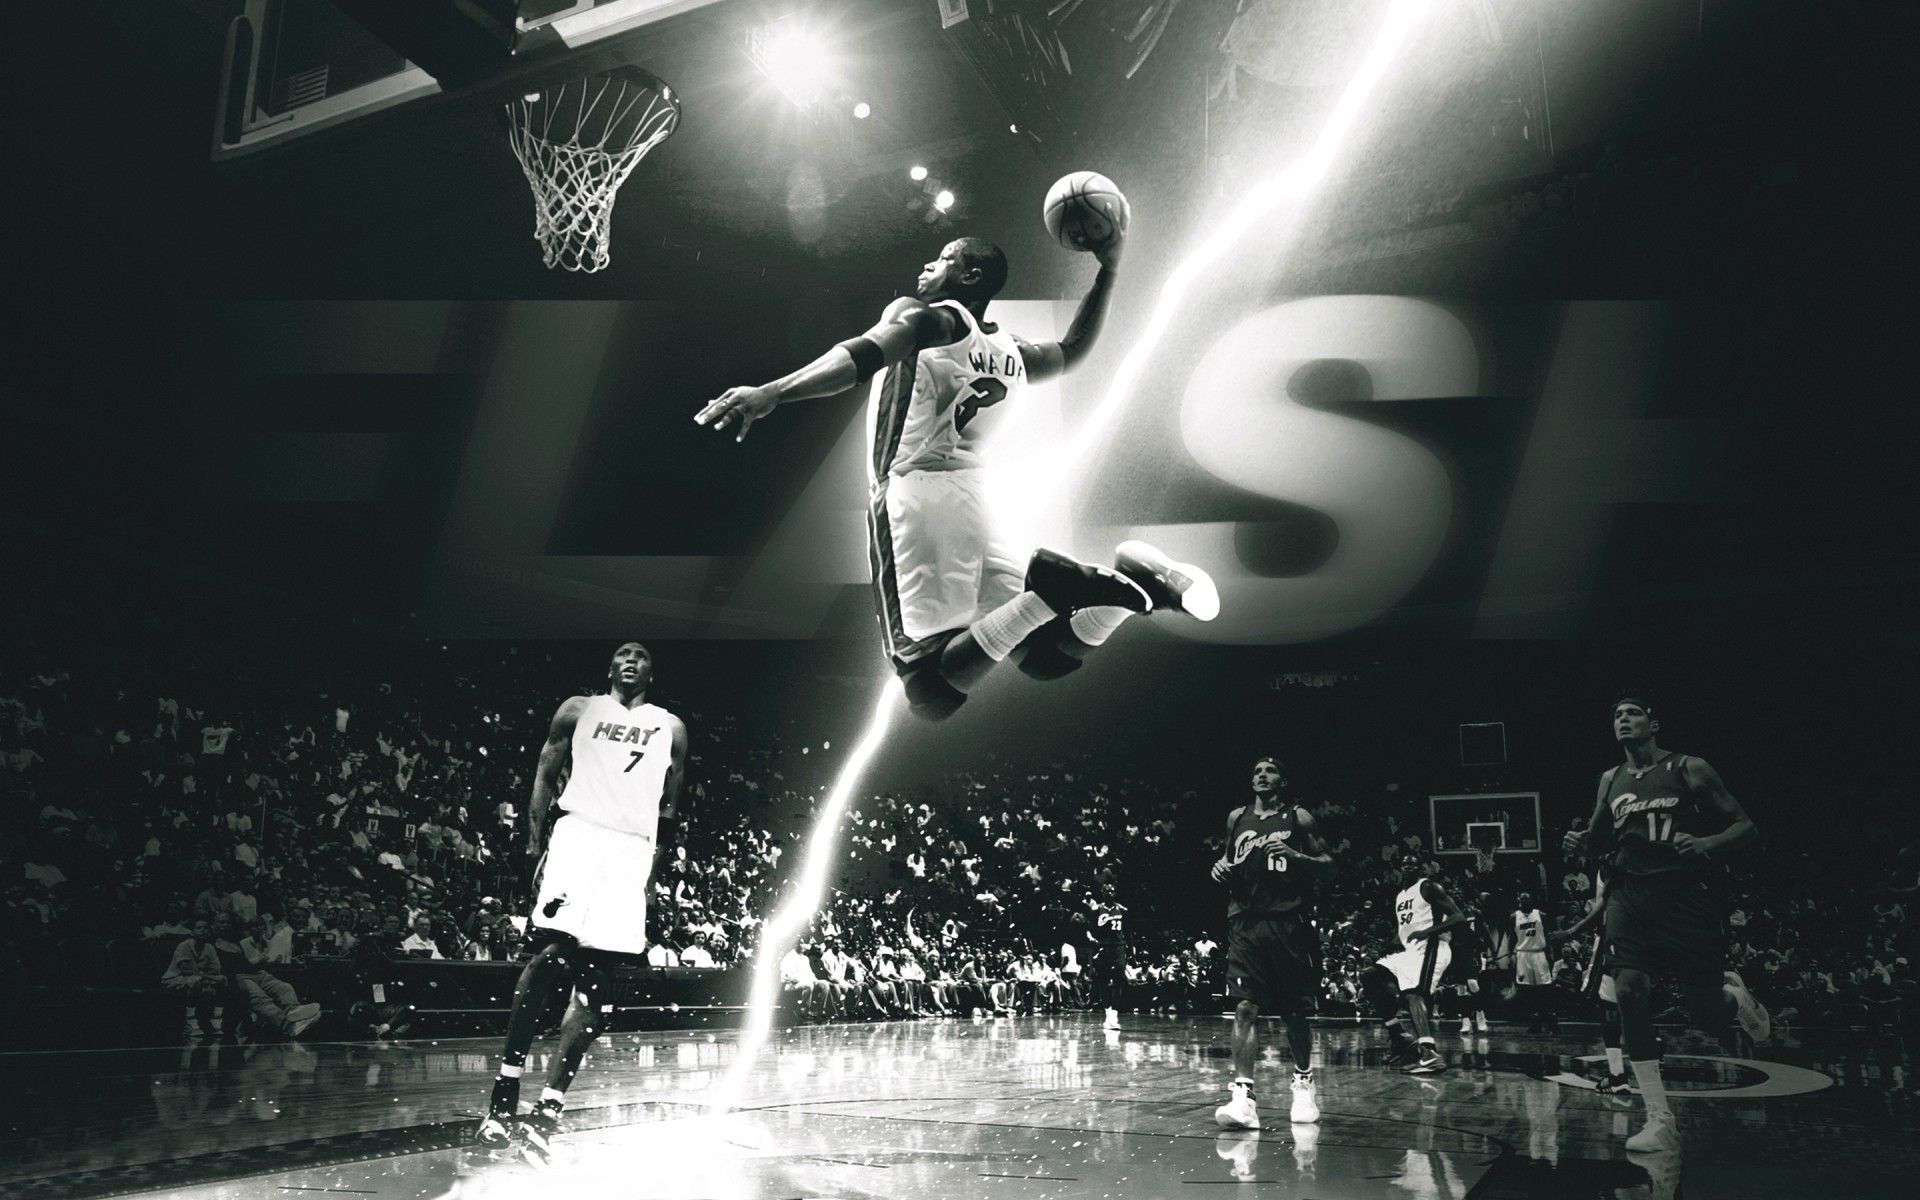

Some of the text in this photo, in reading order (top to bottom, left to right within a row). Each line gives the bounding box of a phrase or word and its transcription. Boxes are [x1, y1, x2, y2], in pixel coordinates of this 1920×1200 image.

[592, 721, 661, 746] HEAT
[623, 750, 645, 773] 7
[1646, 812, 1673, 841] 17
[1397, 899, 1414, 912] EAT
[1400, 912, 1414, 925] 50
